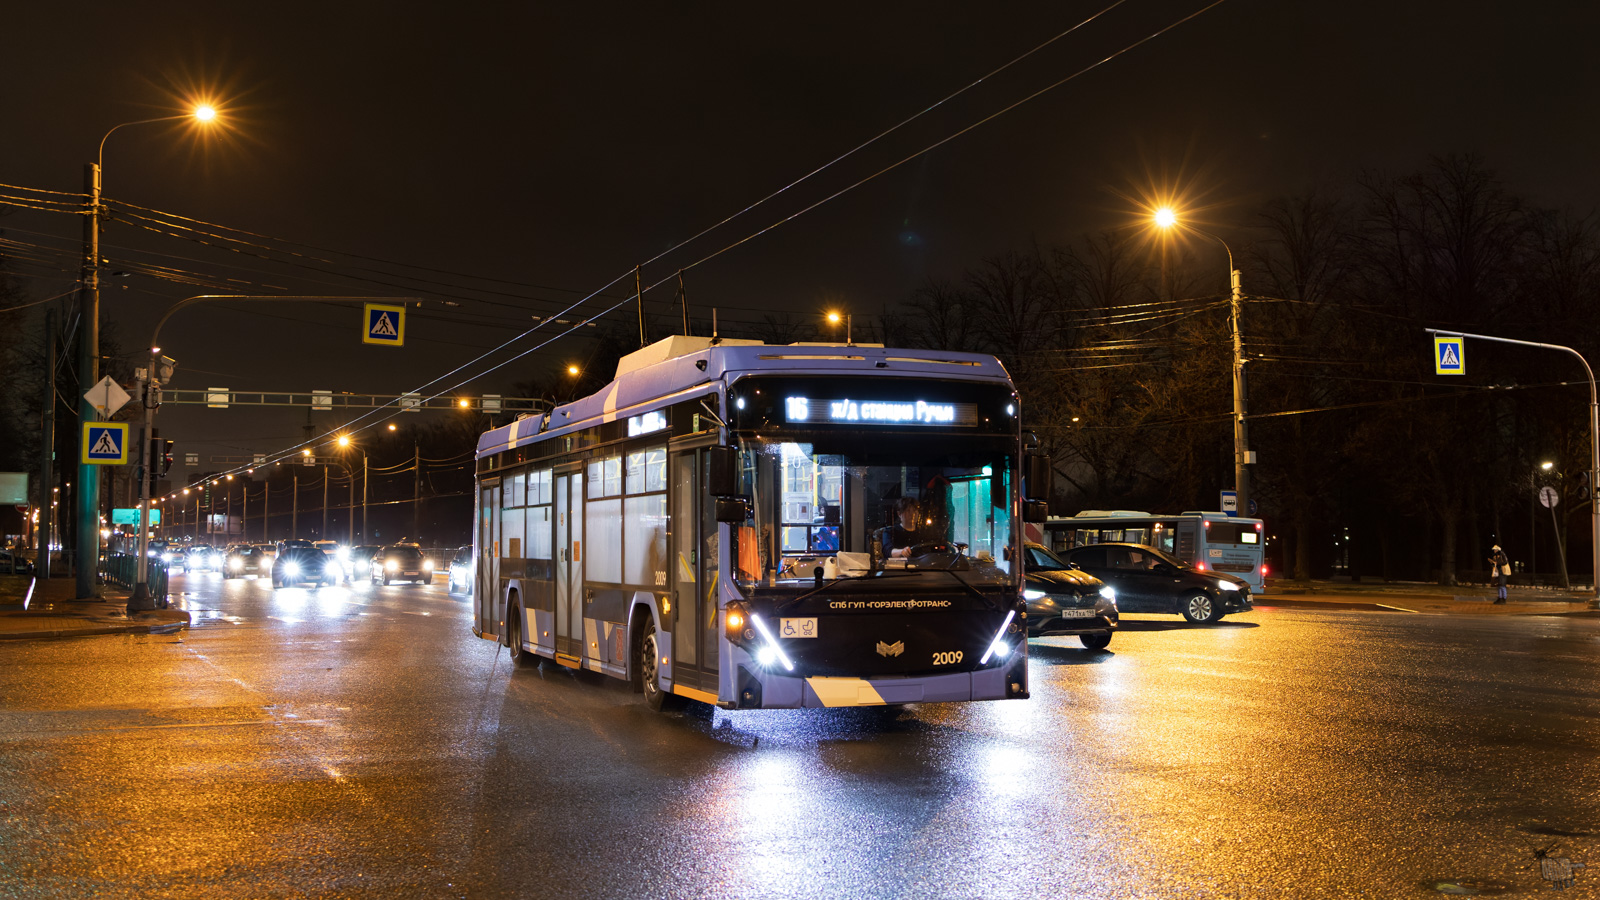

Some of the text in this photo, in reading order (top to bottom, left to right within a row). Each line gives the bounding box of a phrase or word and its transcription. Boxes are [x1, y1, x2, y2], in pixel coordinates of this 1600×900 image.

[787, 397, 954, 422] 16 ж/д станция Ручьи
[655, 570, 667, 586] 2009
[829, 600, 952, 609] СПб ГУП «ГОРЭЛЕКТРОТРАНС»
[932, 651, 963, 666] 2009
